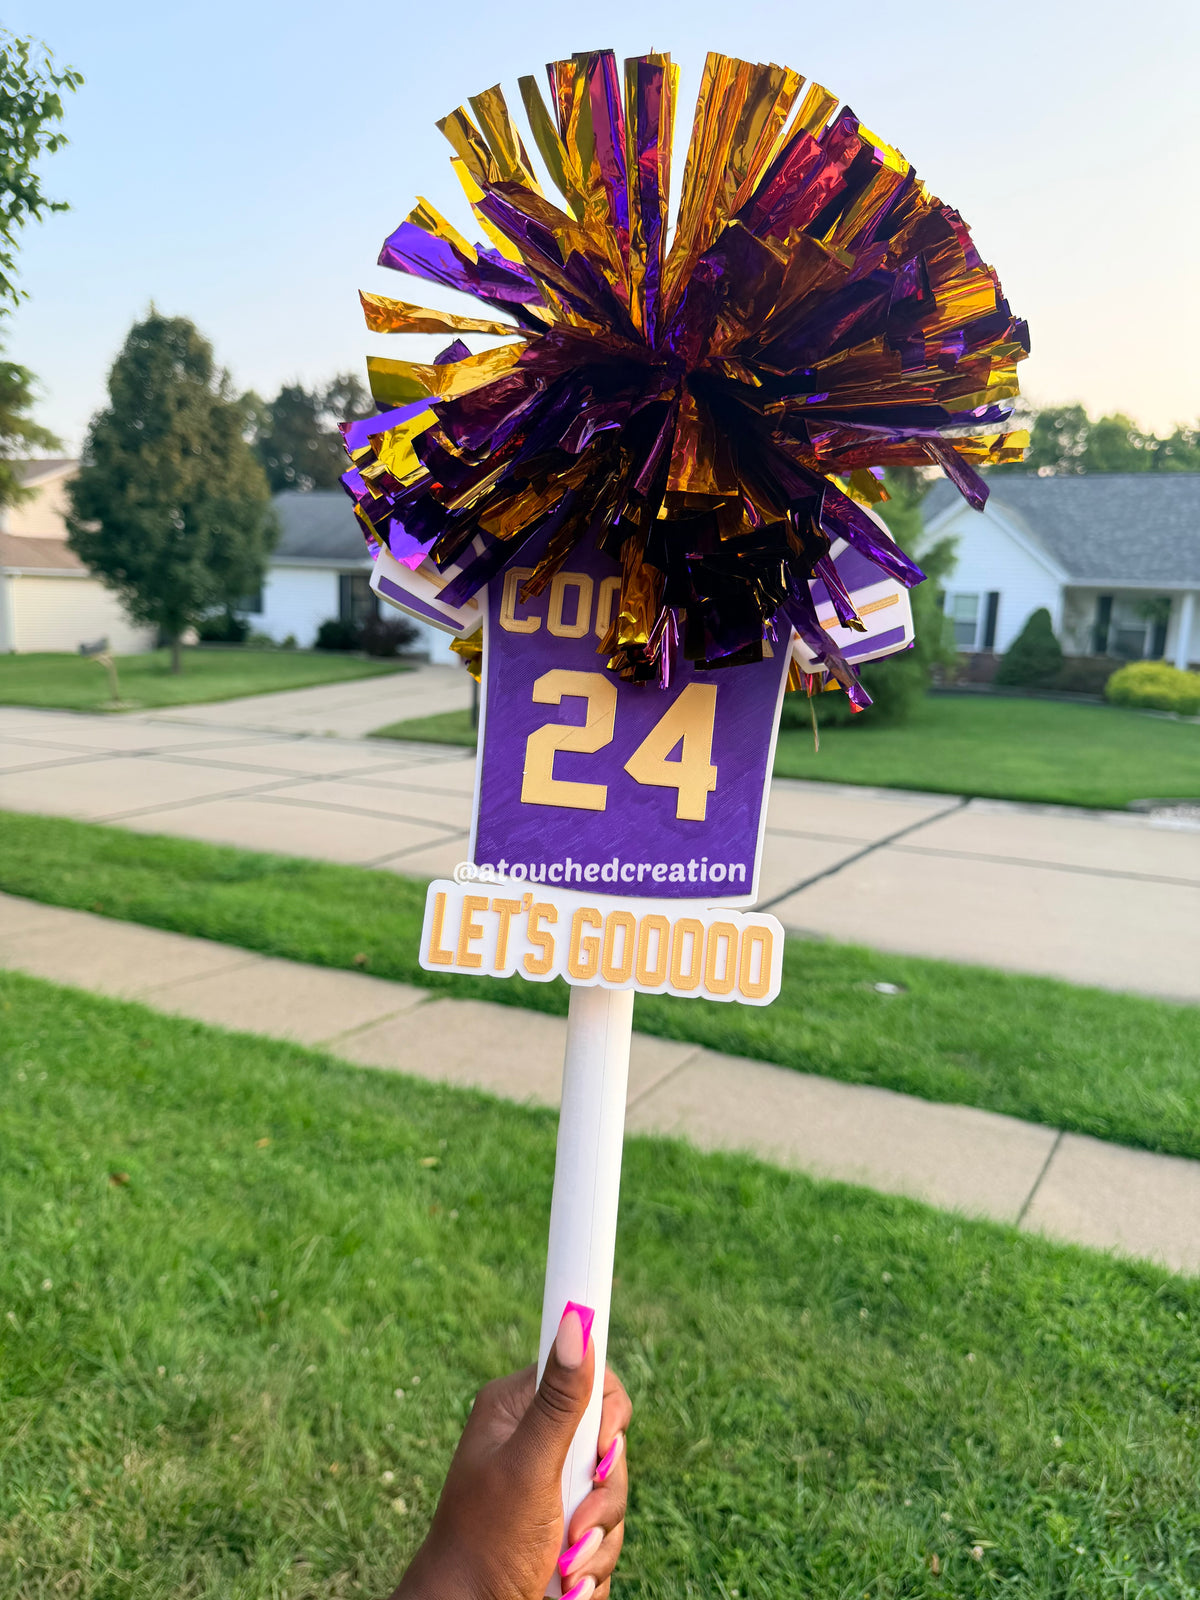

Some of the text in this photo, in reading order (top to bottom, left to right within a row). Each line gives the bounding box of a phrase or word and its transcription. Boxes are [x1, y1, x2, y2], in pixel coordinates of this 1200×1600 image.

[521, 669, 718, 821] 24
[428, 892, 774, 999] LET'S GOOOOO
